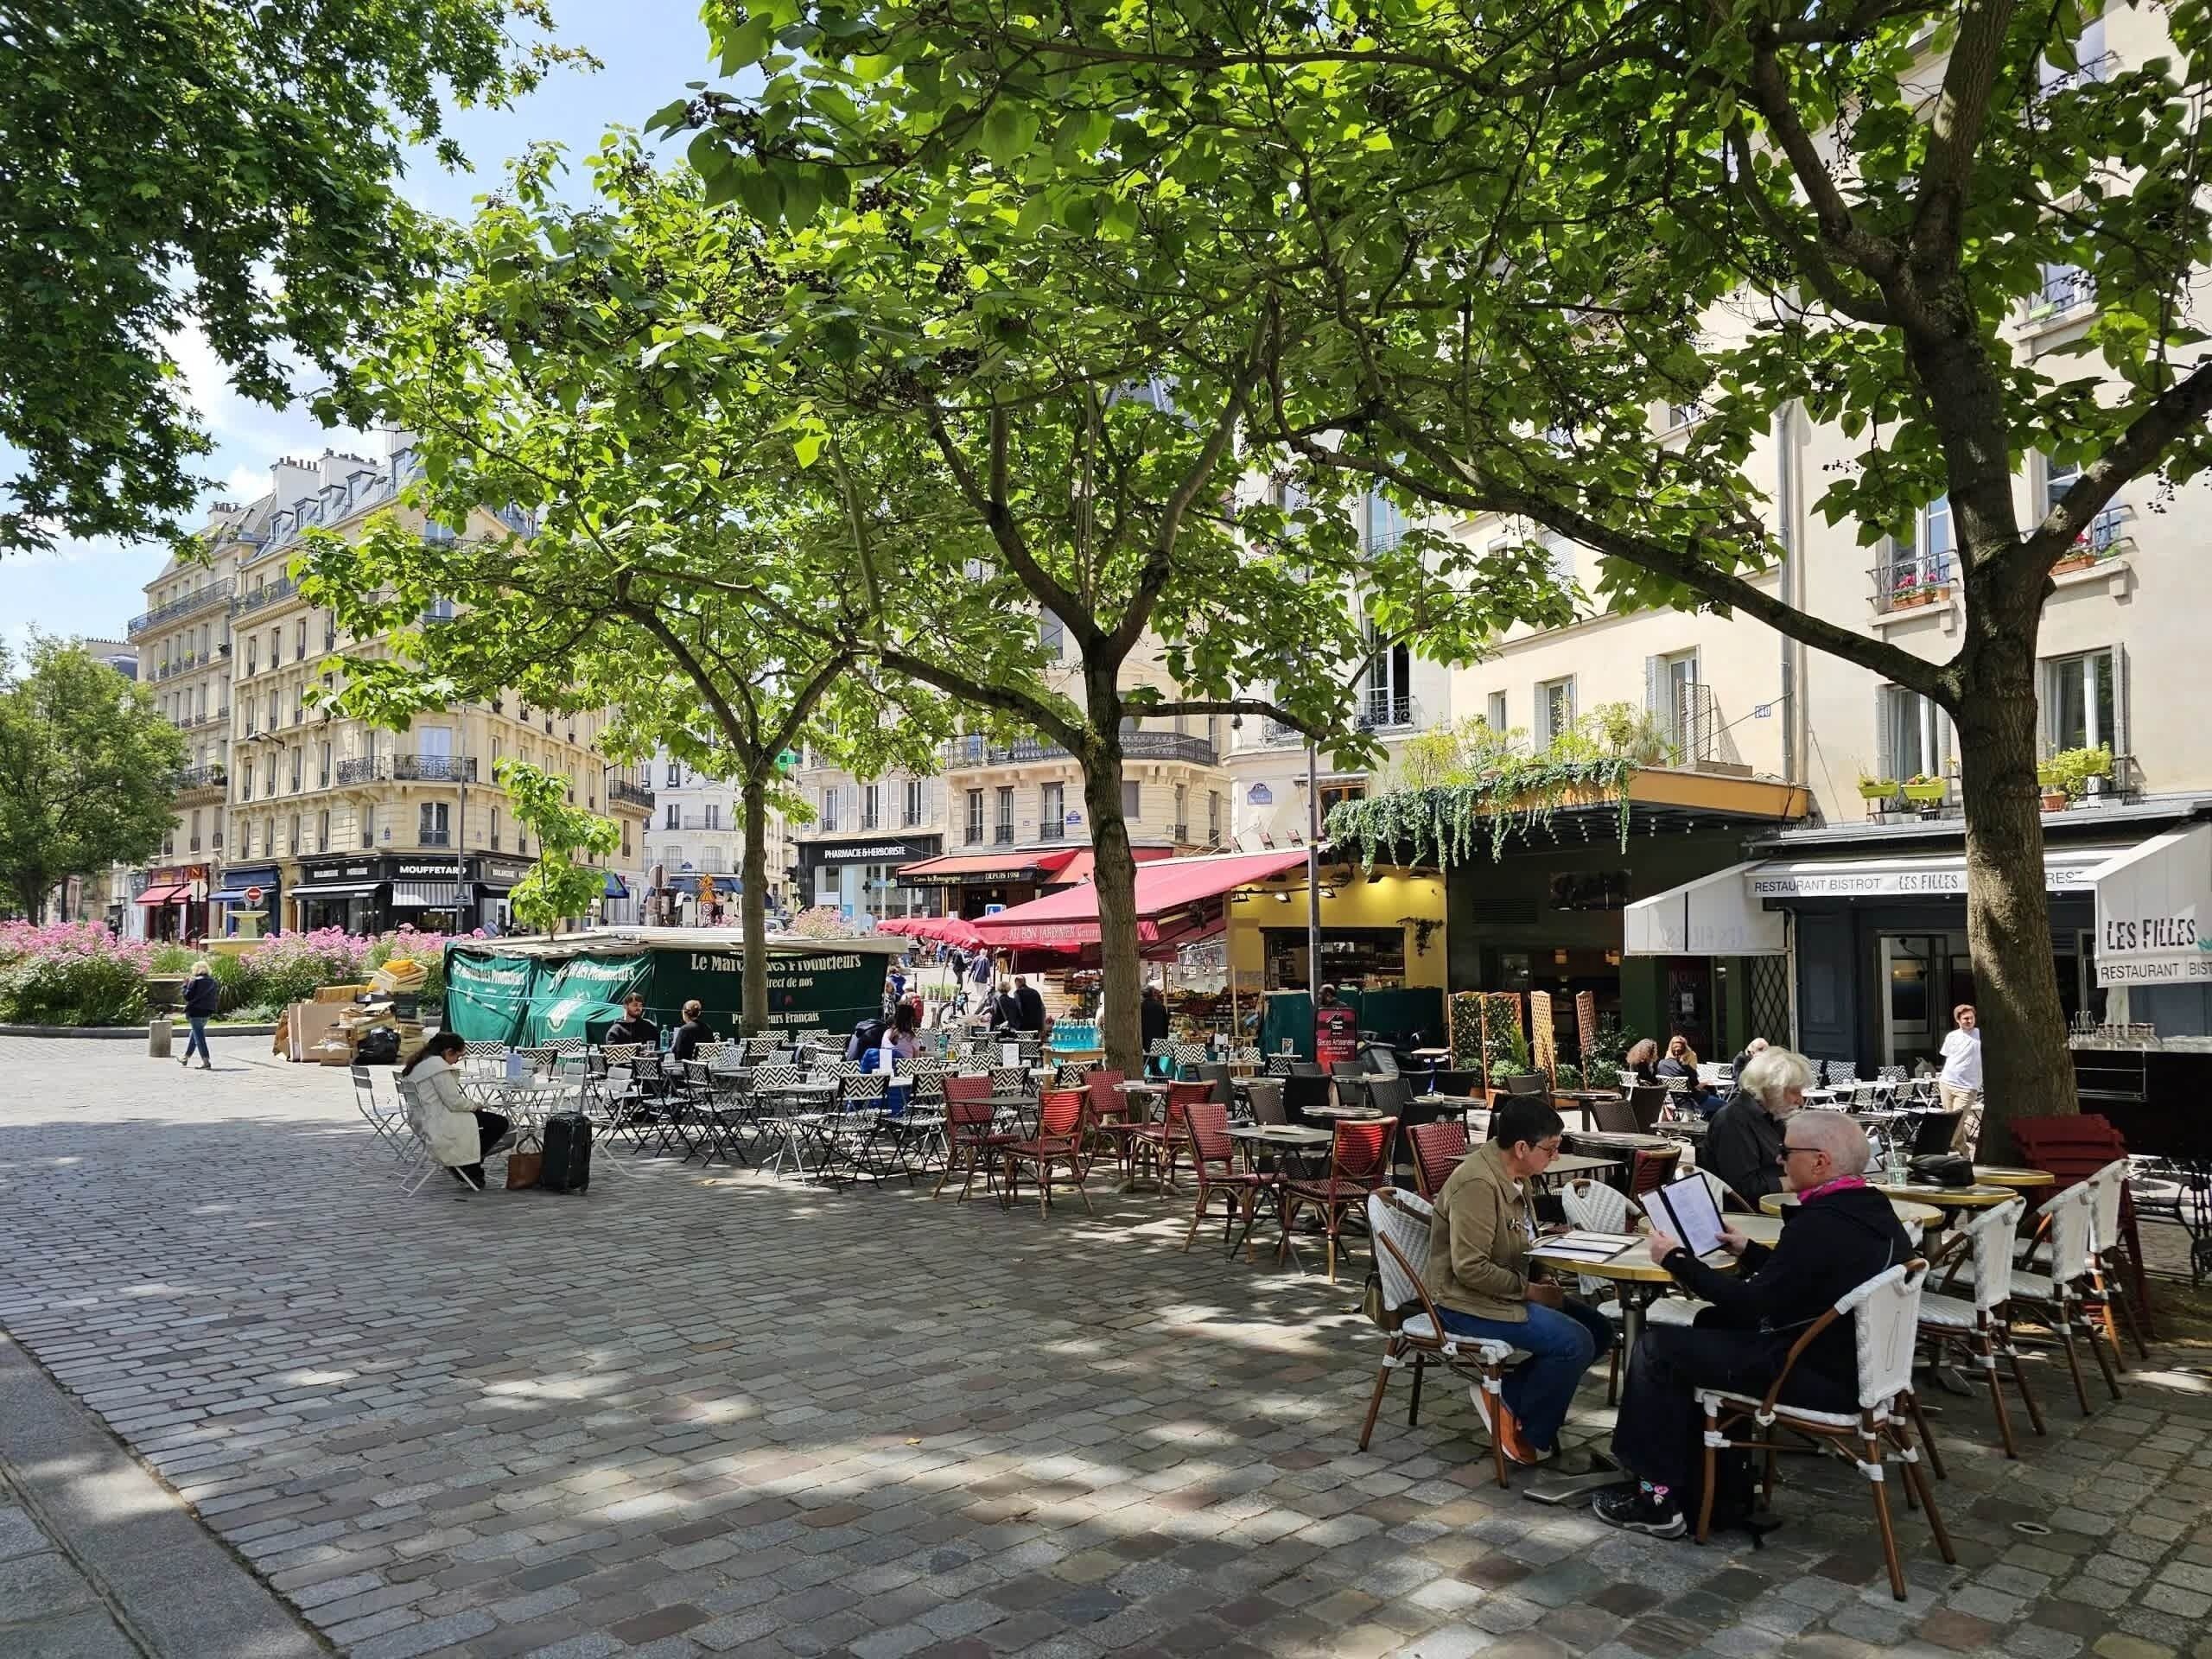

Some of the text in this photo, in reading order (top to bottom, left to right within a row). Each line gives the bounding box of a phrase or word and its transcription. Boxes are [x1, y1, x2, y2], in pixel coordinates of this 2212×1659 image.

[1755, 874, 1958, 892] RESTAURANT BISTROT LES FILLES
[1039, 925, 1075, 940] JARDINIER
[2107, 918, 2196, 950] LES FILLES
[691, 954, 708, 970] Le
[2101, 963, 2179, 981] RESTAURANT
[786, 976, 797, 988] de
[798, 977, 814, 987] nos
[785, 1011, 820, 1024] Français
